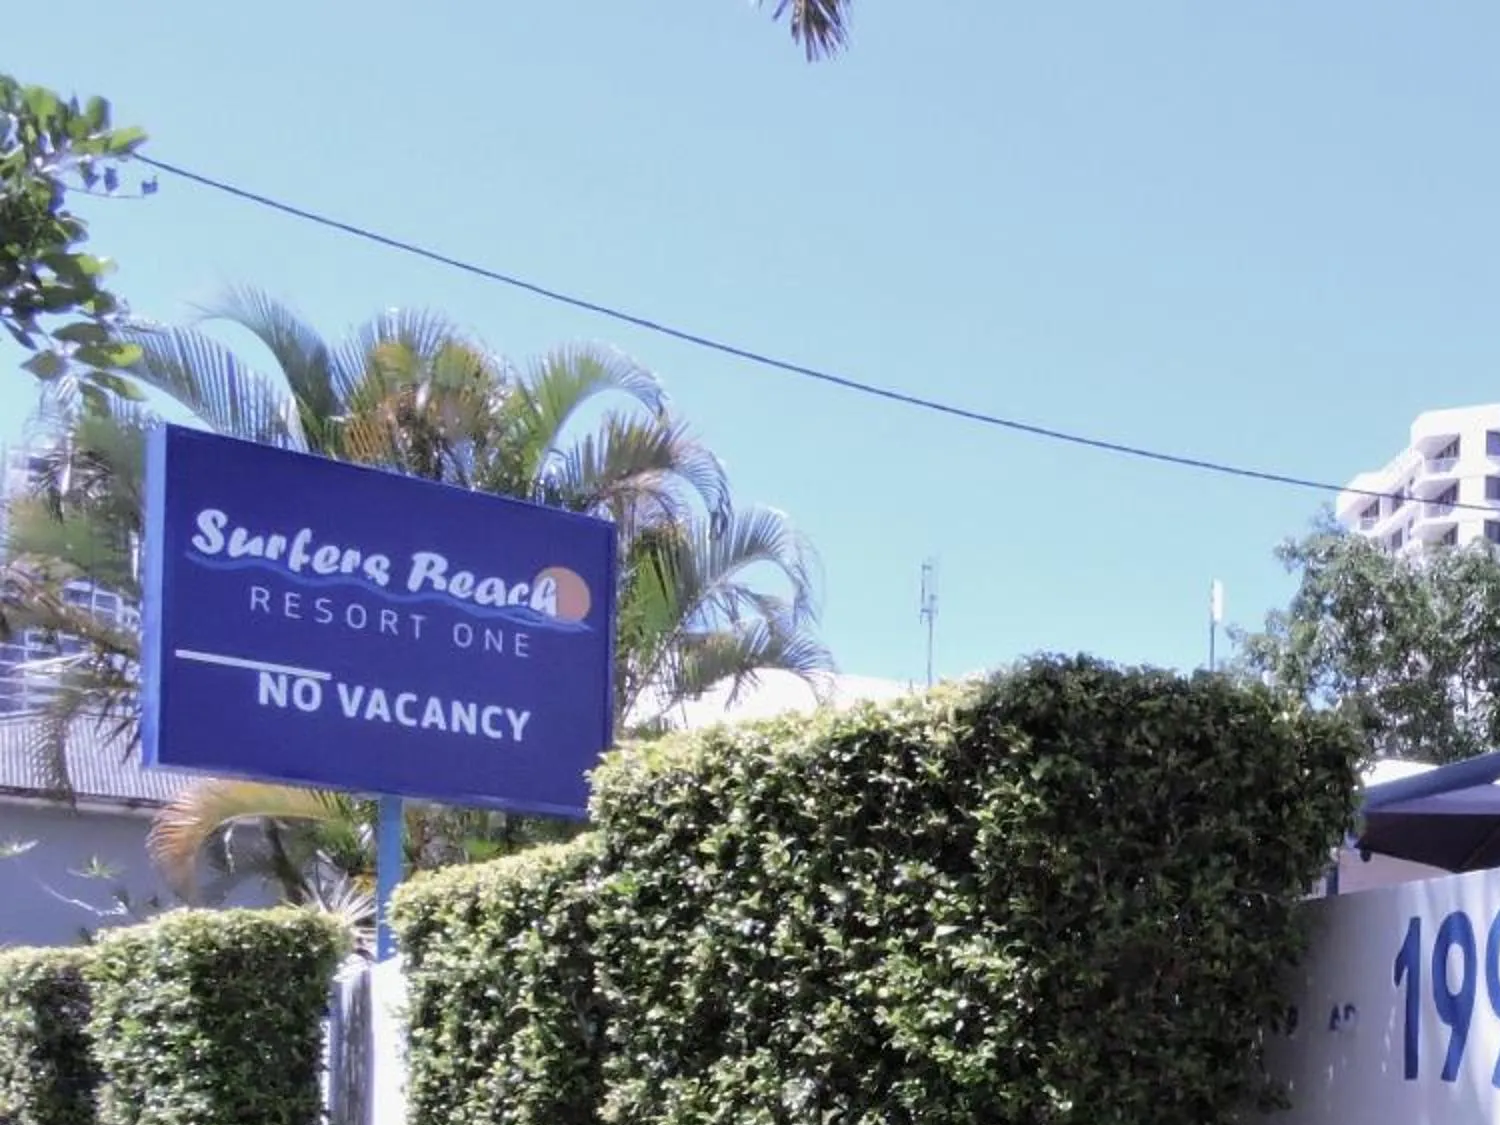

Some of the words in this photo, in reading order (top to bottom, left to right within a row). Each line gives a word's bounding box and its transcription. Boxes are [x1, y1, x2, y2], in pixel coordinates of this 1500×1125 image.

[191, 508, 391, 587] Surfers
[407, 551, 557, 618] Beach
[250, 586, 427, 640] RESORT
[453, 623, 531, 658] ONE
[258, 672, 321, 712] NO
[337, 682, 531, 743] VACANCY
